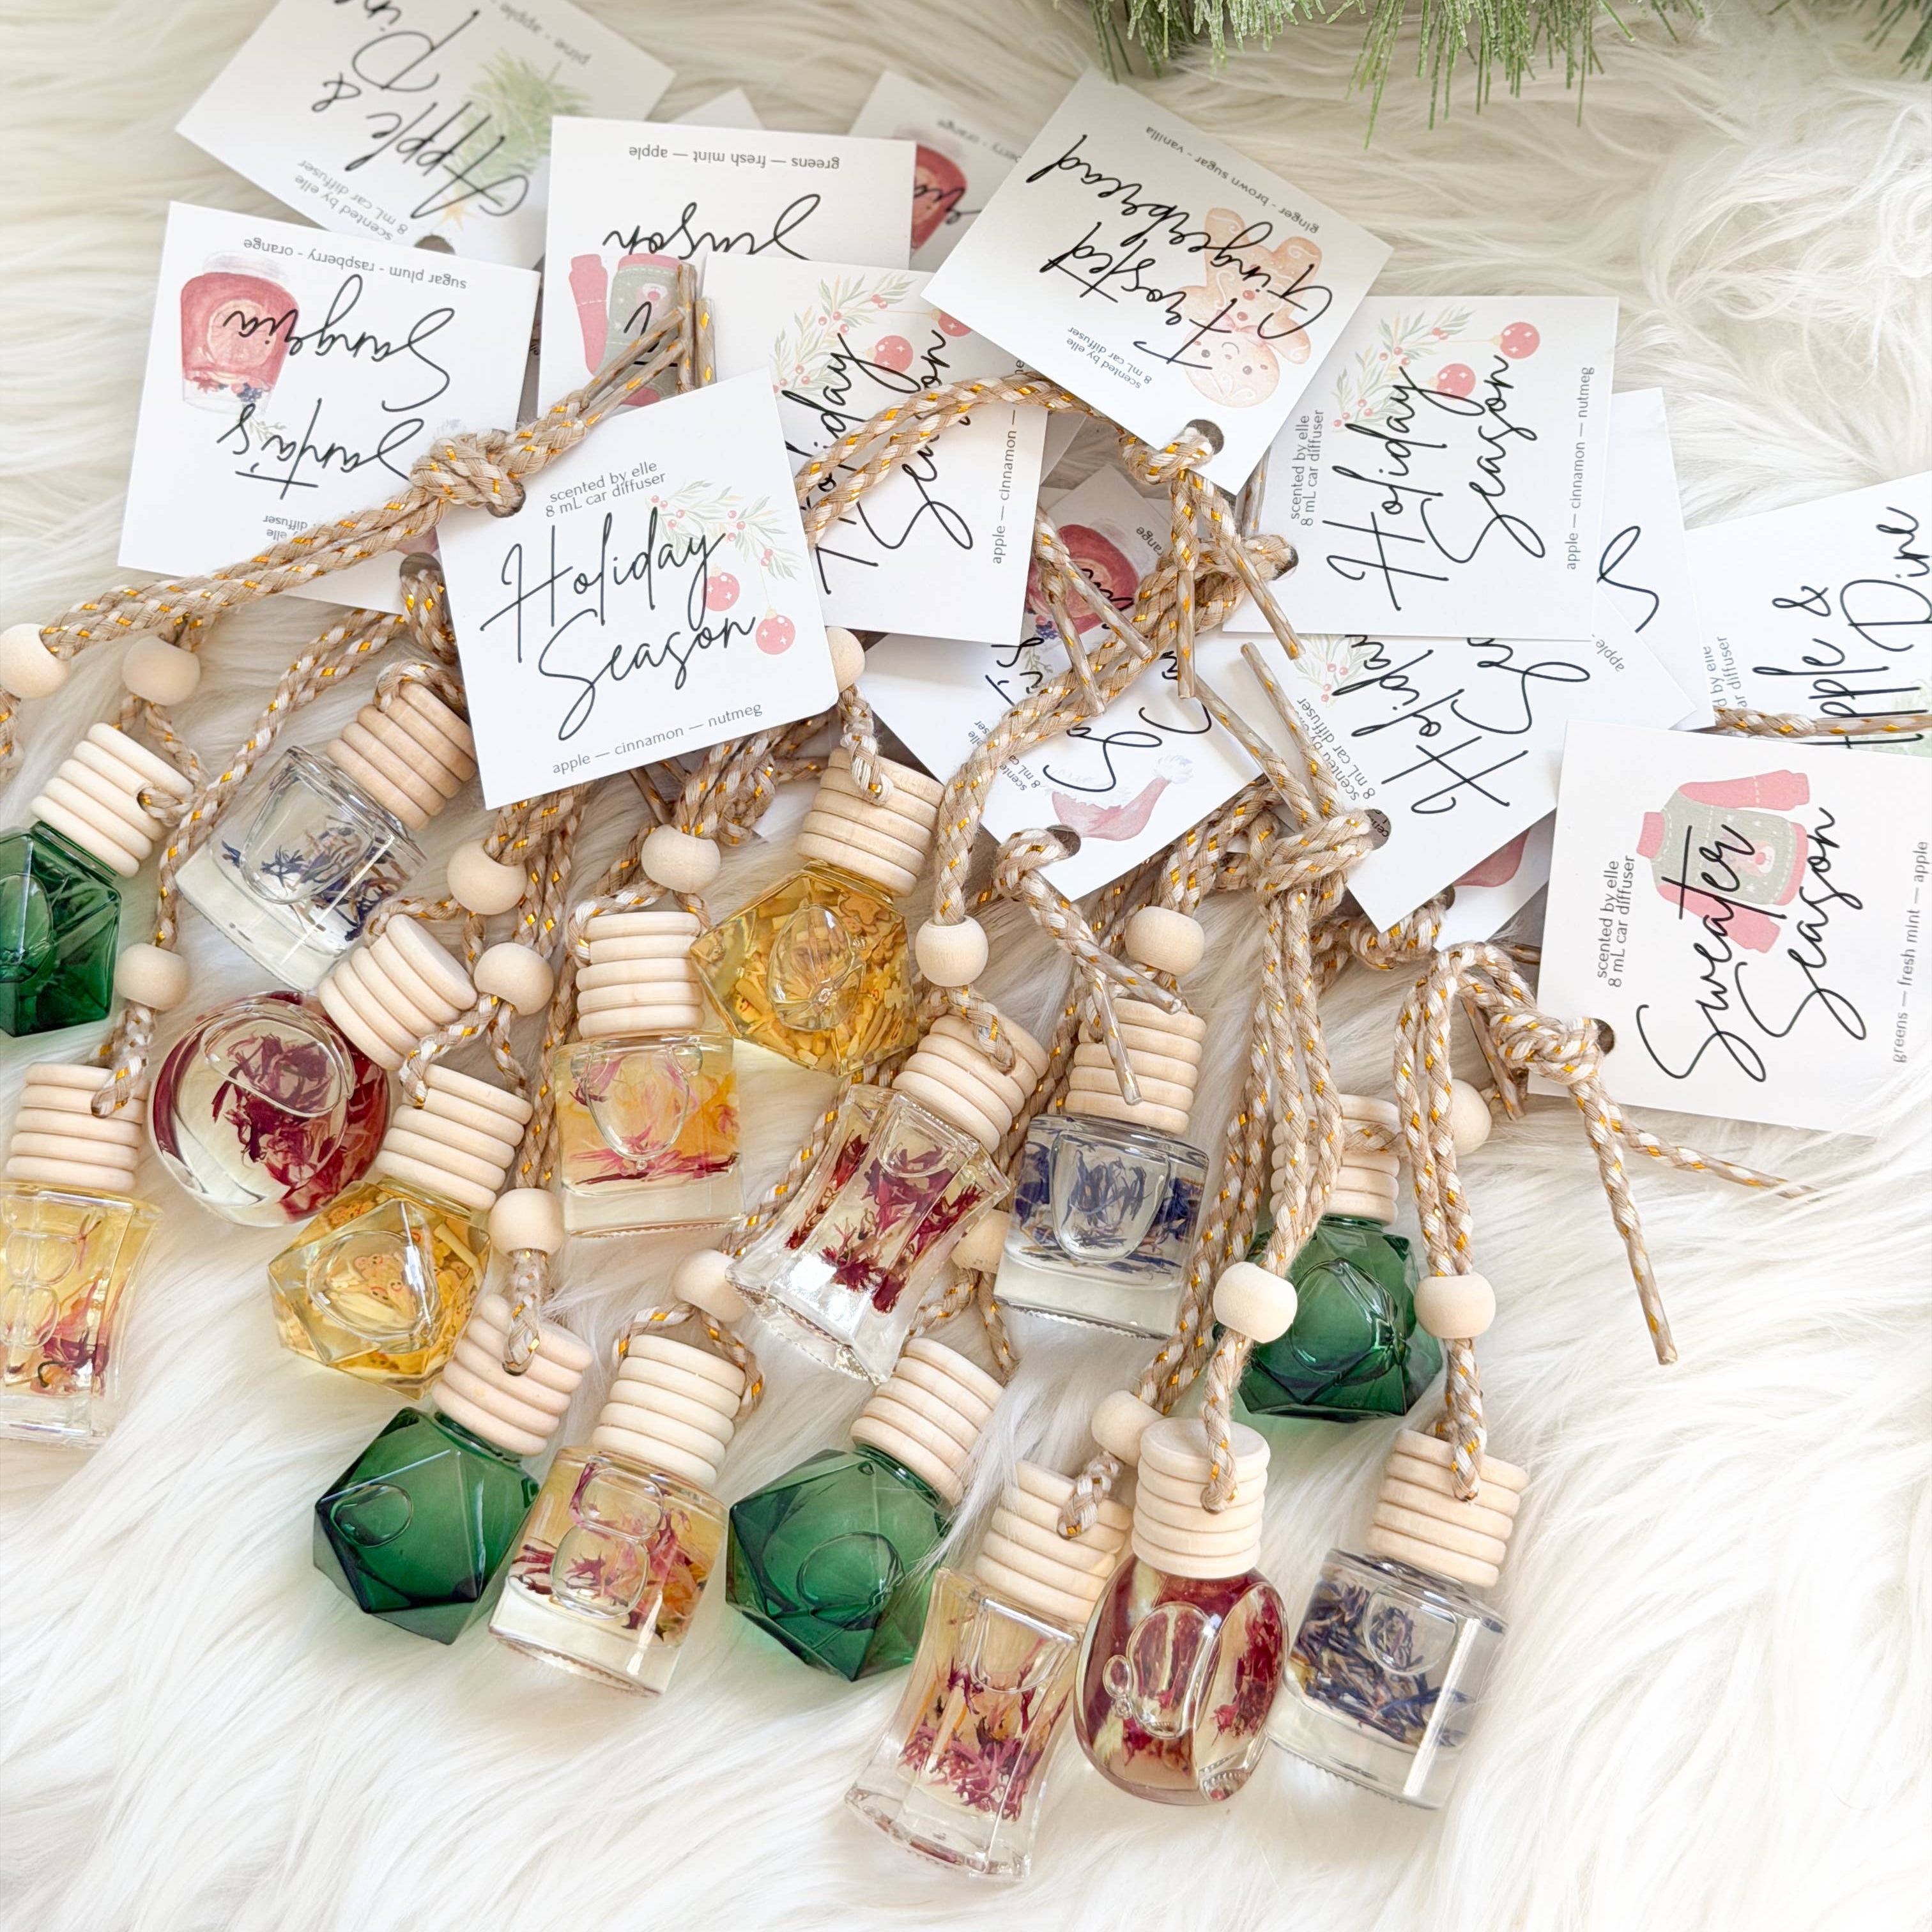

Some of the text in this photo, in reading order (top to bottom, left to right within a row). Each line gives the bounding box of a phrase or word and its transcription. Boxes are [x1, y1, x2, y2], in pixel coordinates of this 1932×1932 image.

[334, 0, 479, 92] Pin
[312, 73, 529, 219] Apple &
[629, 145, 669, 160] apple
[693, 151, 726, 163] mint
[730, 153, 767, 169] fresh
[1145, 126, 1184, 153] vanilla
[791, 157, 841, 169] greens
[1194, 156, 1229, 180] sugar
[295, 175, 394, 241] scented by elle
[298, 160, 409, 236] 8 mL car diffuser
[1230, 176, 1270, 207] brown
[1026, 134, 1333, 339] Gingerbread
[1278, 206, 1320, 234] ginger
[243, 237, 294, 256] orange
[307, 248, 375, 272] raspberry
[389, 266, 425, 284] plum
[427, 273, 468, 289] sugar
[1039, 222, 1238, 371] Frosted
[222, 274, 454, 412] Sangria
[1066, 338, 1142, 388] scented by elle
[1067, 326, 1152, 384] 8 mL car diffuser
[1576, 366, 1595, 417] nutmeg
[549, 461, 658, 503] scented by elle
[999, 431, 1017, 501] cinnamon
[1291, 415, 1309, 519] scented by elle
[1301, 410, 1324, 526] 8 mL car diffuser
[1420, 355, 1545, 564] Season
[1569, 441, 1585, 509] cinnamon
[546, 473, 666, 518] 8 mL car diffuser
[1322, 367, 1485, 610] Holiday
[263, 515, 308, 532] diffuser
[992, 525, 1007, 564] apple
[1136, 526, 1164, 556] range
[1565, 532, 1581, 571] apple
[480, 507, 726, 663] Holiday
[539, 608, 756, 741] Season
[1595, 639, 1625, 671] apple
[1717, 636, 1742, 690] diffuser
[1753, 586, 1928, 749] pple &
[552, 754, 591, 775] apple
[614, 727, 684, 755] cinnamon
[708, 704, 763, 727] nutmeg
[1297, 698, 1335, 743] diffuser
[999, 761, 1027, 791] scente
[1009, 755, 1041, 788] 8 mL ca
[1332, 746, 1351, 764] car
[1347, 764, 1368, 786] mL
[1363, 788, 1376, 800] 8
[1912, 841, 1930, 883] apple
[1597, 861, 1620, 978] scented by elle
[1607, 855, 1635, 987] 8 mL car diffuser
[1735, 807, 1866, 1040] Season
[1905, 909, 1920, 943] mint
[1636, 824, 1787, 1082] Sweater
[1897, 948, 1916, 986] fresh
[1893, 1011, 1908, 1064] greens
